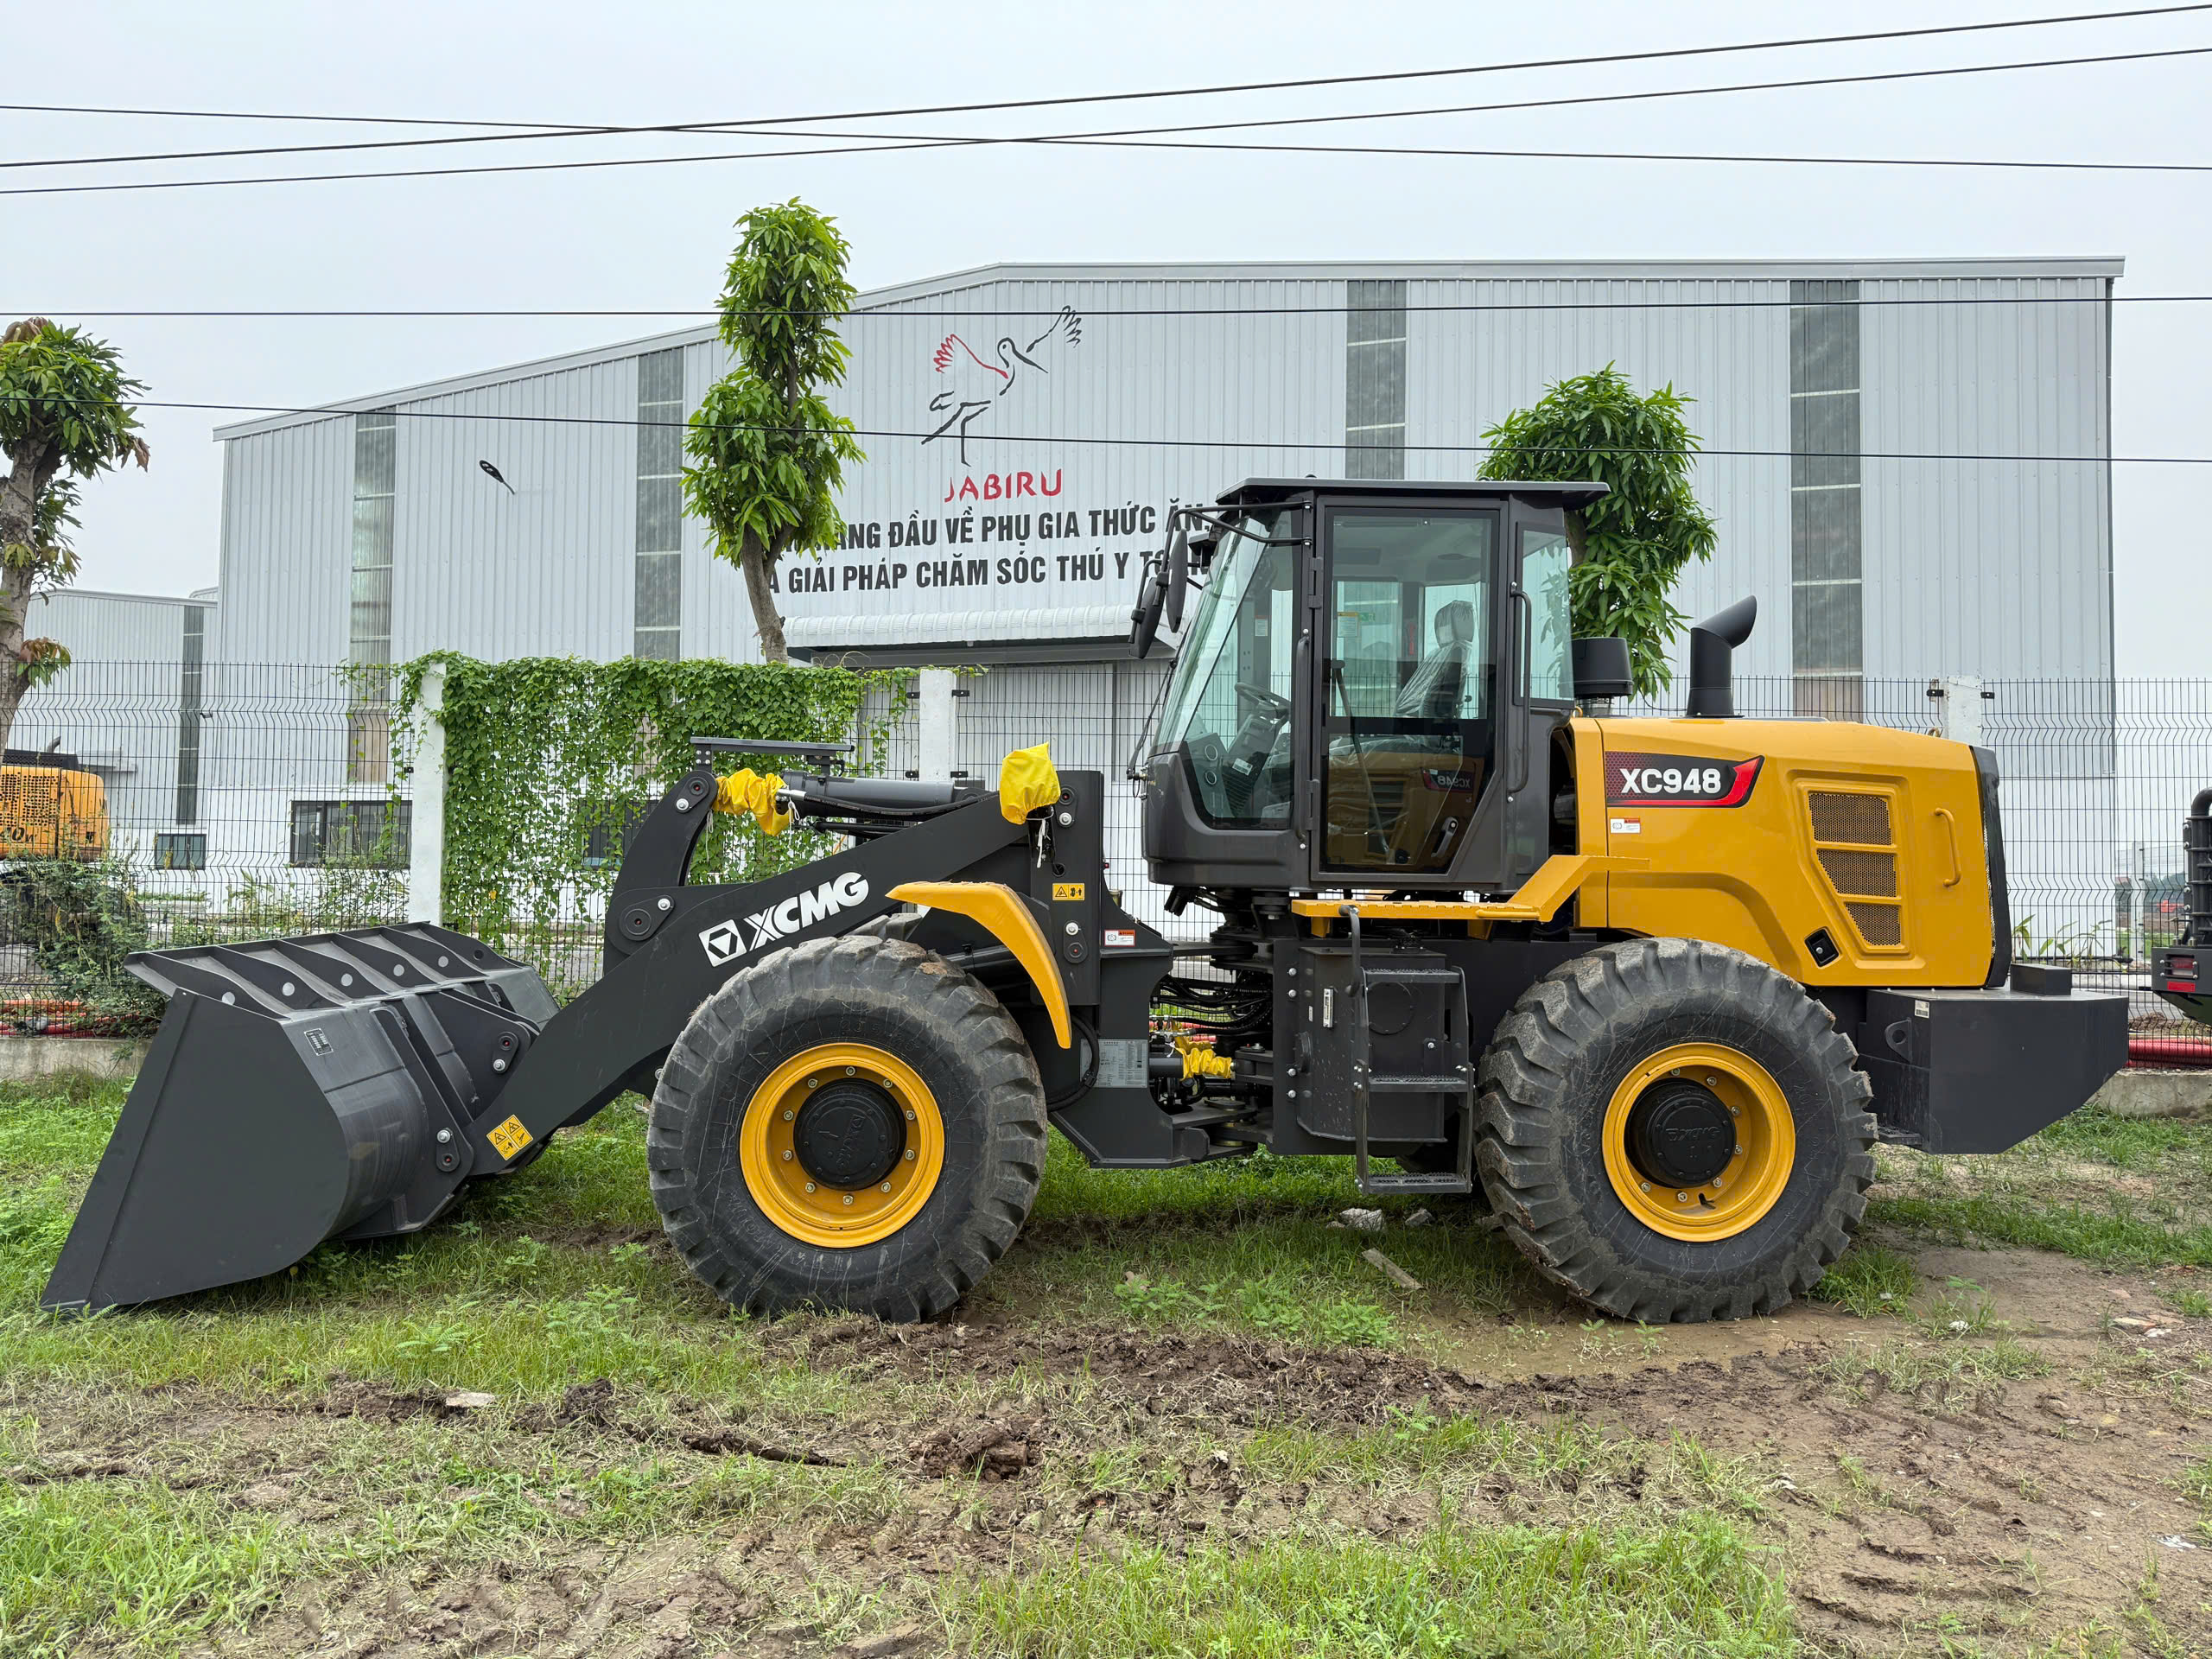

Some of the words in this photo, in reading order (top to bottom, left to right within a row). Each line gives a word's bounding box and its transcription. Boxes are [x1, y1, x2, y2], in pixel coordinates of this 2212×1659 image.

[944, 468, 1062, 503] JABIRU
[888, 509, 937, 548] ĐẦU
[945, 505, 974, 544] VỀ
[982, 513, 1031, 546] PHỤ
[1038, 512, 1080, 540] GIA
[1088, 500, 1156, 537] THỨC
[789, 556, 835, 594] GIẢI
[843, 557, 907, 592] PHÁP
[916, 552, 988, 588] CHĂM
[996, 550, 1046, 585] SÓC
[1056, 546, 1103, 582] THÚ
[1114, 552, 1129, 579] Y
[1619, 768, 1721, 794] XC948
[743, 872, 869, 951] XCMG
